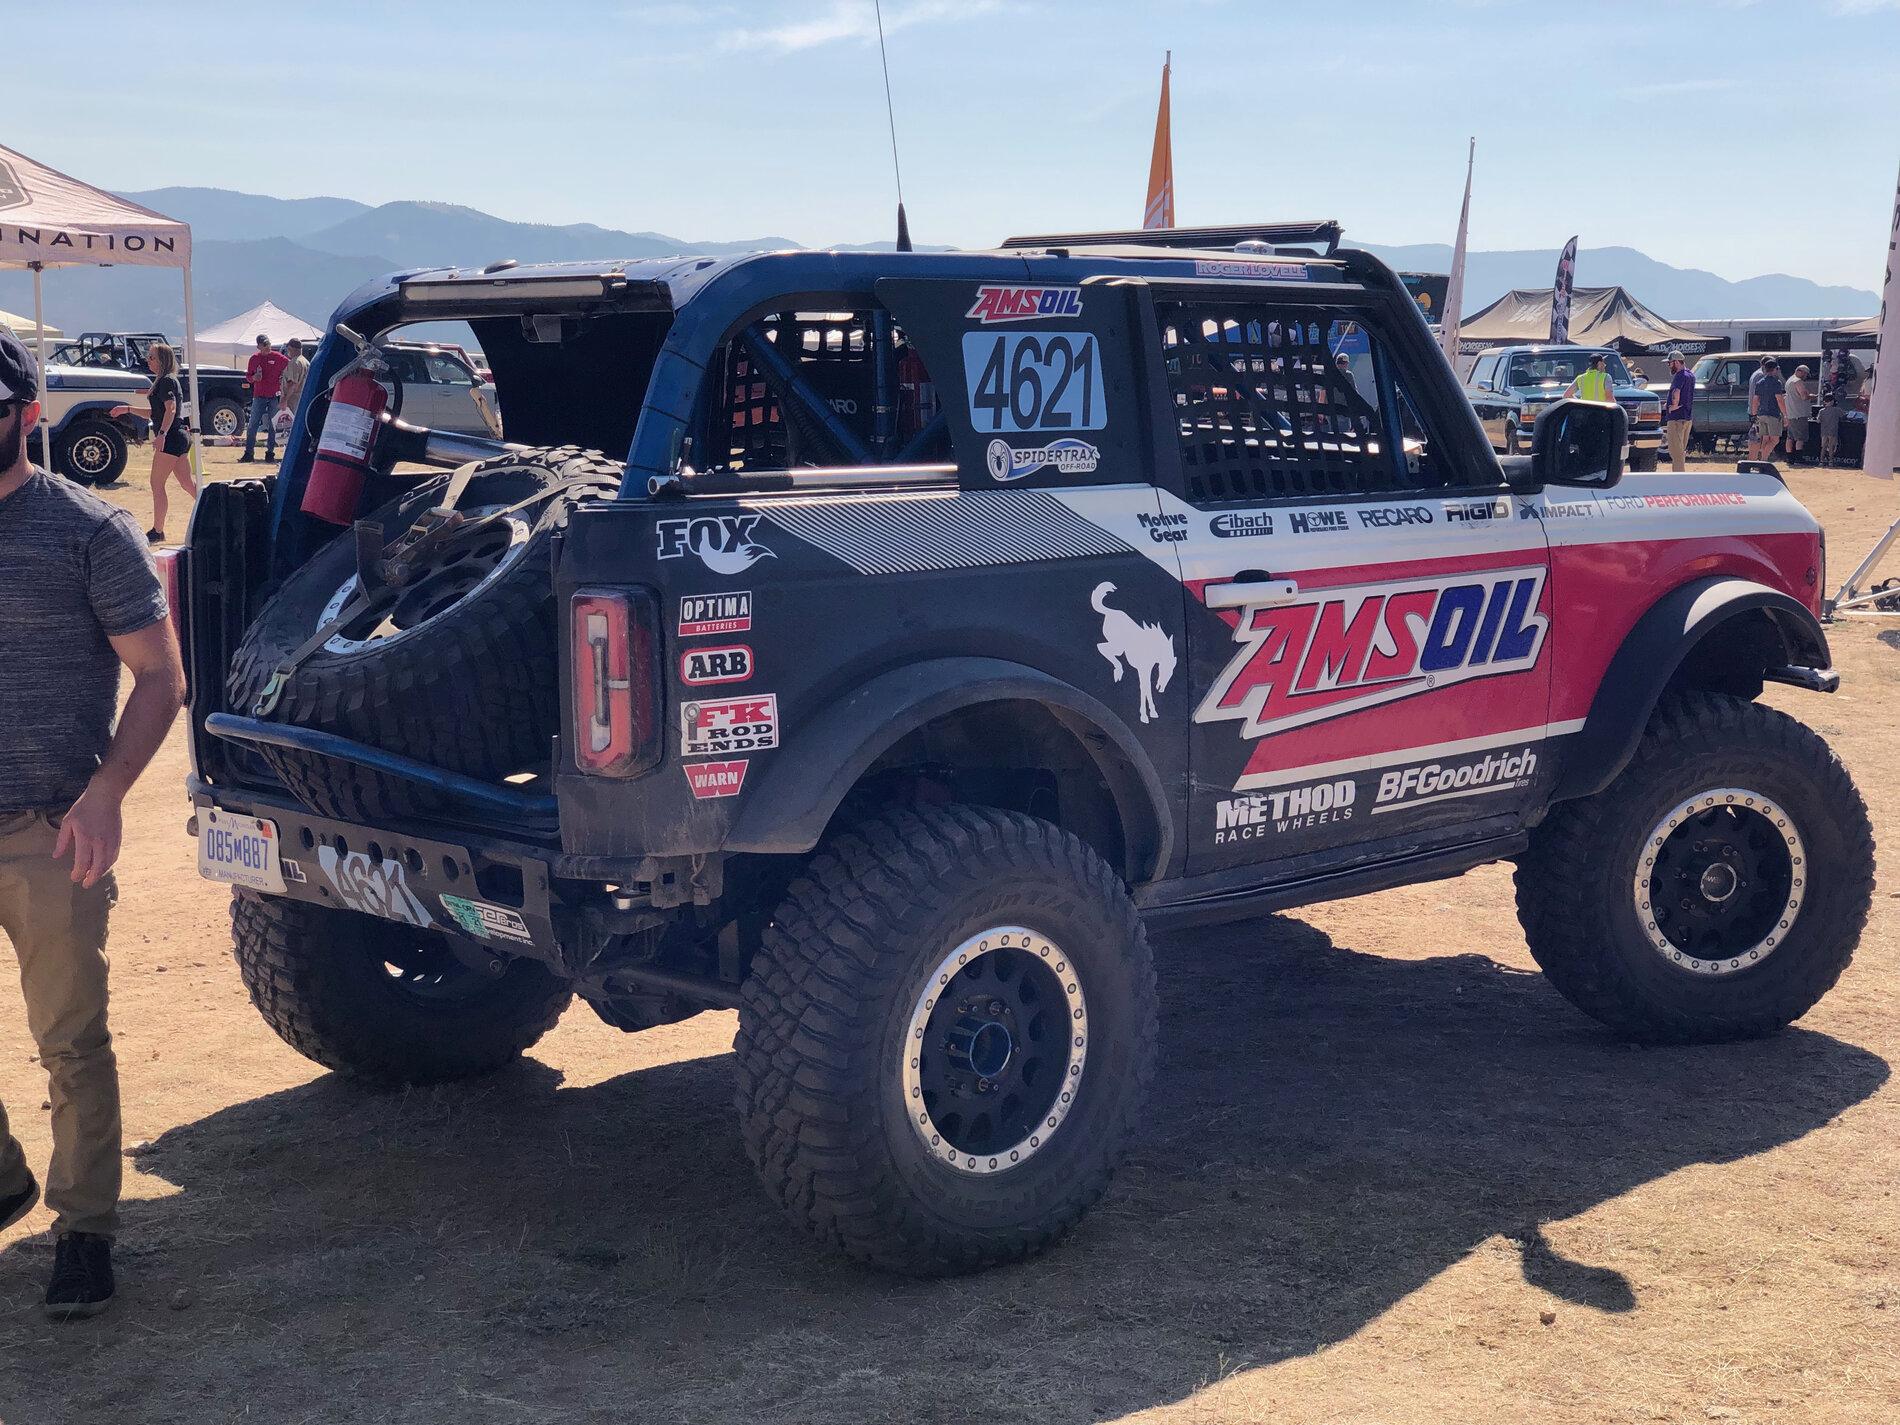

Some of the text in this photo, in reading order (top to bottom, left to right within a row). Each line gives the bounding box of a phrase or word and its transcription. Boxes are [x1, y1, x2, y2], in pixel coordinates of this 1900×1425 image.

[972, 288, 1082, 321] AMSOIL
[1647, 341, 1698, 353] WILD HORSES
[973, 335, 1093, 430] 4621
[1013, 447, 1097, 464] SPIDERTRAX
[1060, 462, 1096, 471] OFF-ROAD
[1446, 501, 1509, 522] RIGID
[1605, 491, 1747, 510] FORD PERFORMANCE
[1136, 512, 1188, 528] Motive
[1209, 511, 1273, 538] Eibach
[1357, 506, 1434, 528] RECARO
[656, 513, 768, 564] FOX
[1150, 527, 1188, 543] Gear
[683, 596, 749, 621] OPTIMA
[695, 621, 738, 632] BATTERIES
[1216, 577, 1540, 725] AMSOIL
[688, 651, 748, 679] ARB
[697, 701, 772, 727] FK
[707, 723, 774, 740] ROD
[687, 735, 774, 754] ENDS
[694, 771, 738, 788] WARN
[1376, 748, 1537, 804] BFGoodrich
[1215, 779, 1357, 830] METHOD
[1215, 807, 1353, 845] RACE WHEELS
